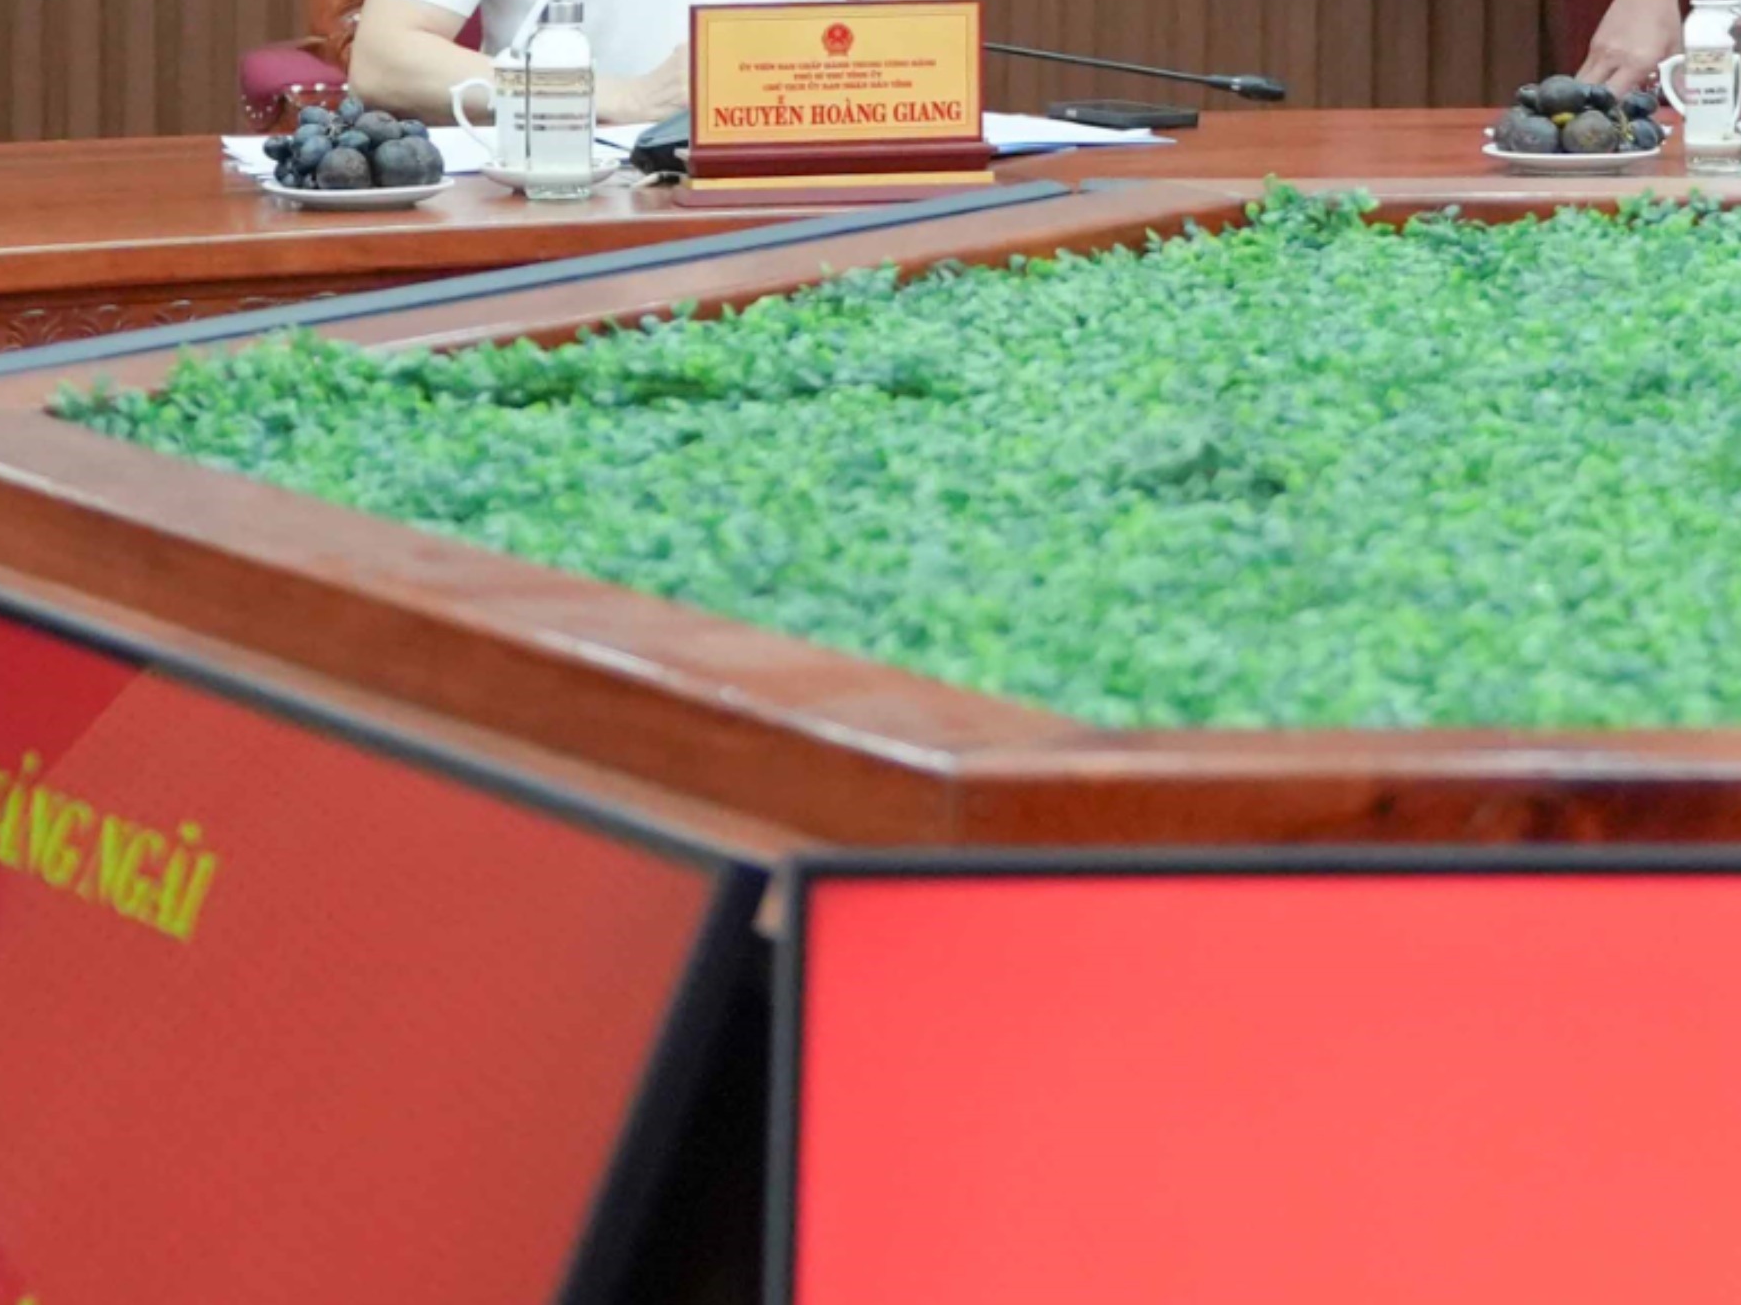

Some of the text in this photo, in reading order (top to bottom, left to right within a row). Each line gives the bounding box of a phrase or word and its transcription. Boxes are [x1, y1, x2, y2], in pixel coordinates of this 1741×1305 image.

[713, 95, 962, 127] NGUYỄN HOÀNG GIANG
[75, 820, 218, 943] NGÃI
